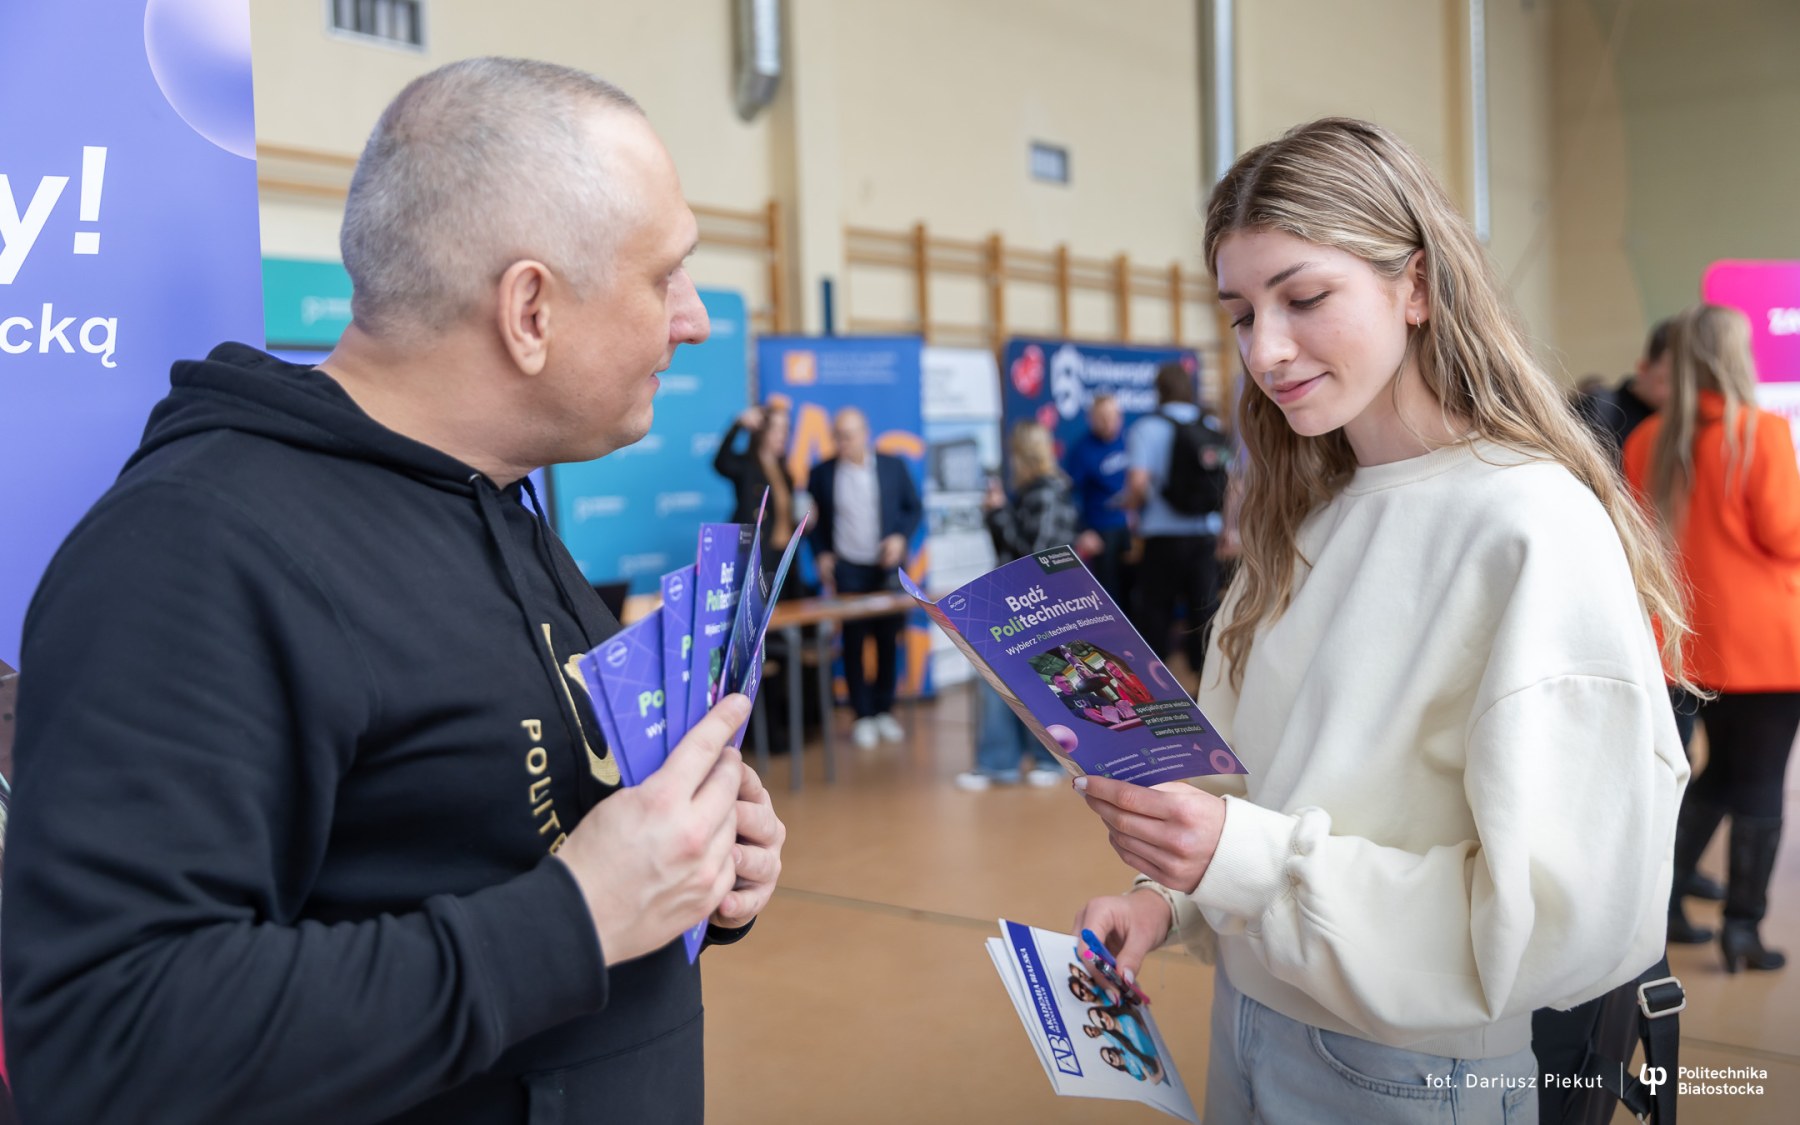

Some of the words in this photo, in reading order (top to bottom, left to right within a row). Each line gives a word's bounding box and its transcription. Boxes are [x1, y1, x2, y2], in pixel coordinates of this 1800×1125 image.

[0, 146, 108, 285] y!
[0, 302, 118, 369] cką
[989, 590, 1104, 642] Politechniczny!
[1004, 584, 1048, 613] Bądź
[1005, 637, 1038, 656] Wybierz
[1036, 622, 1078, 642] Politechnikę
[1076, 613, 1116, 630] Białostocką
